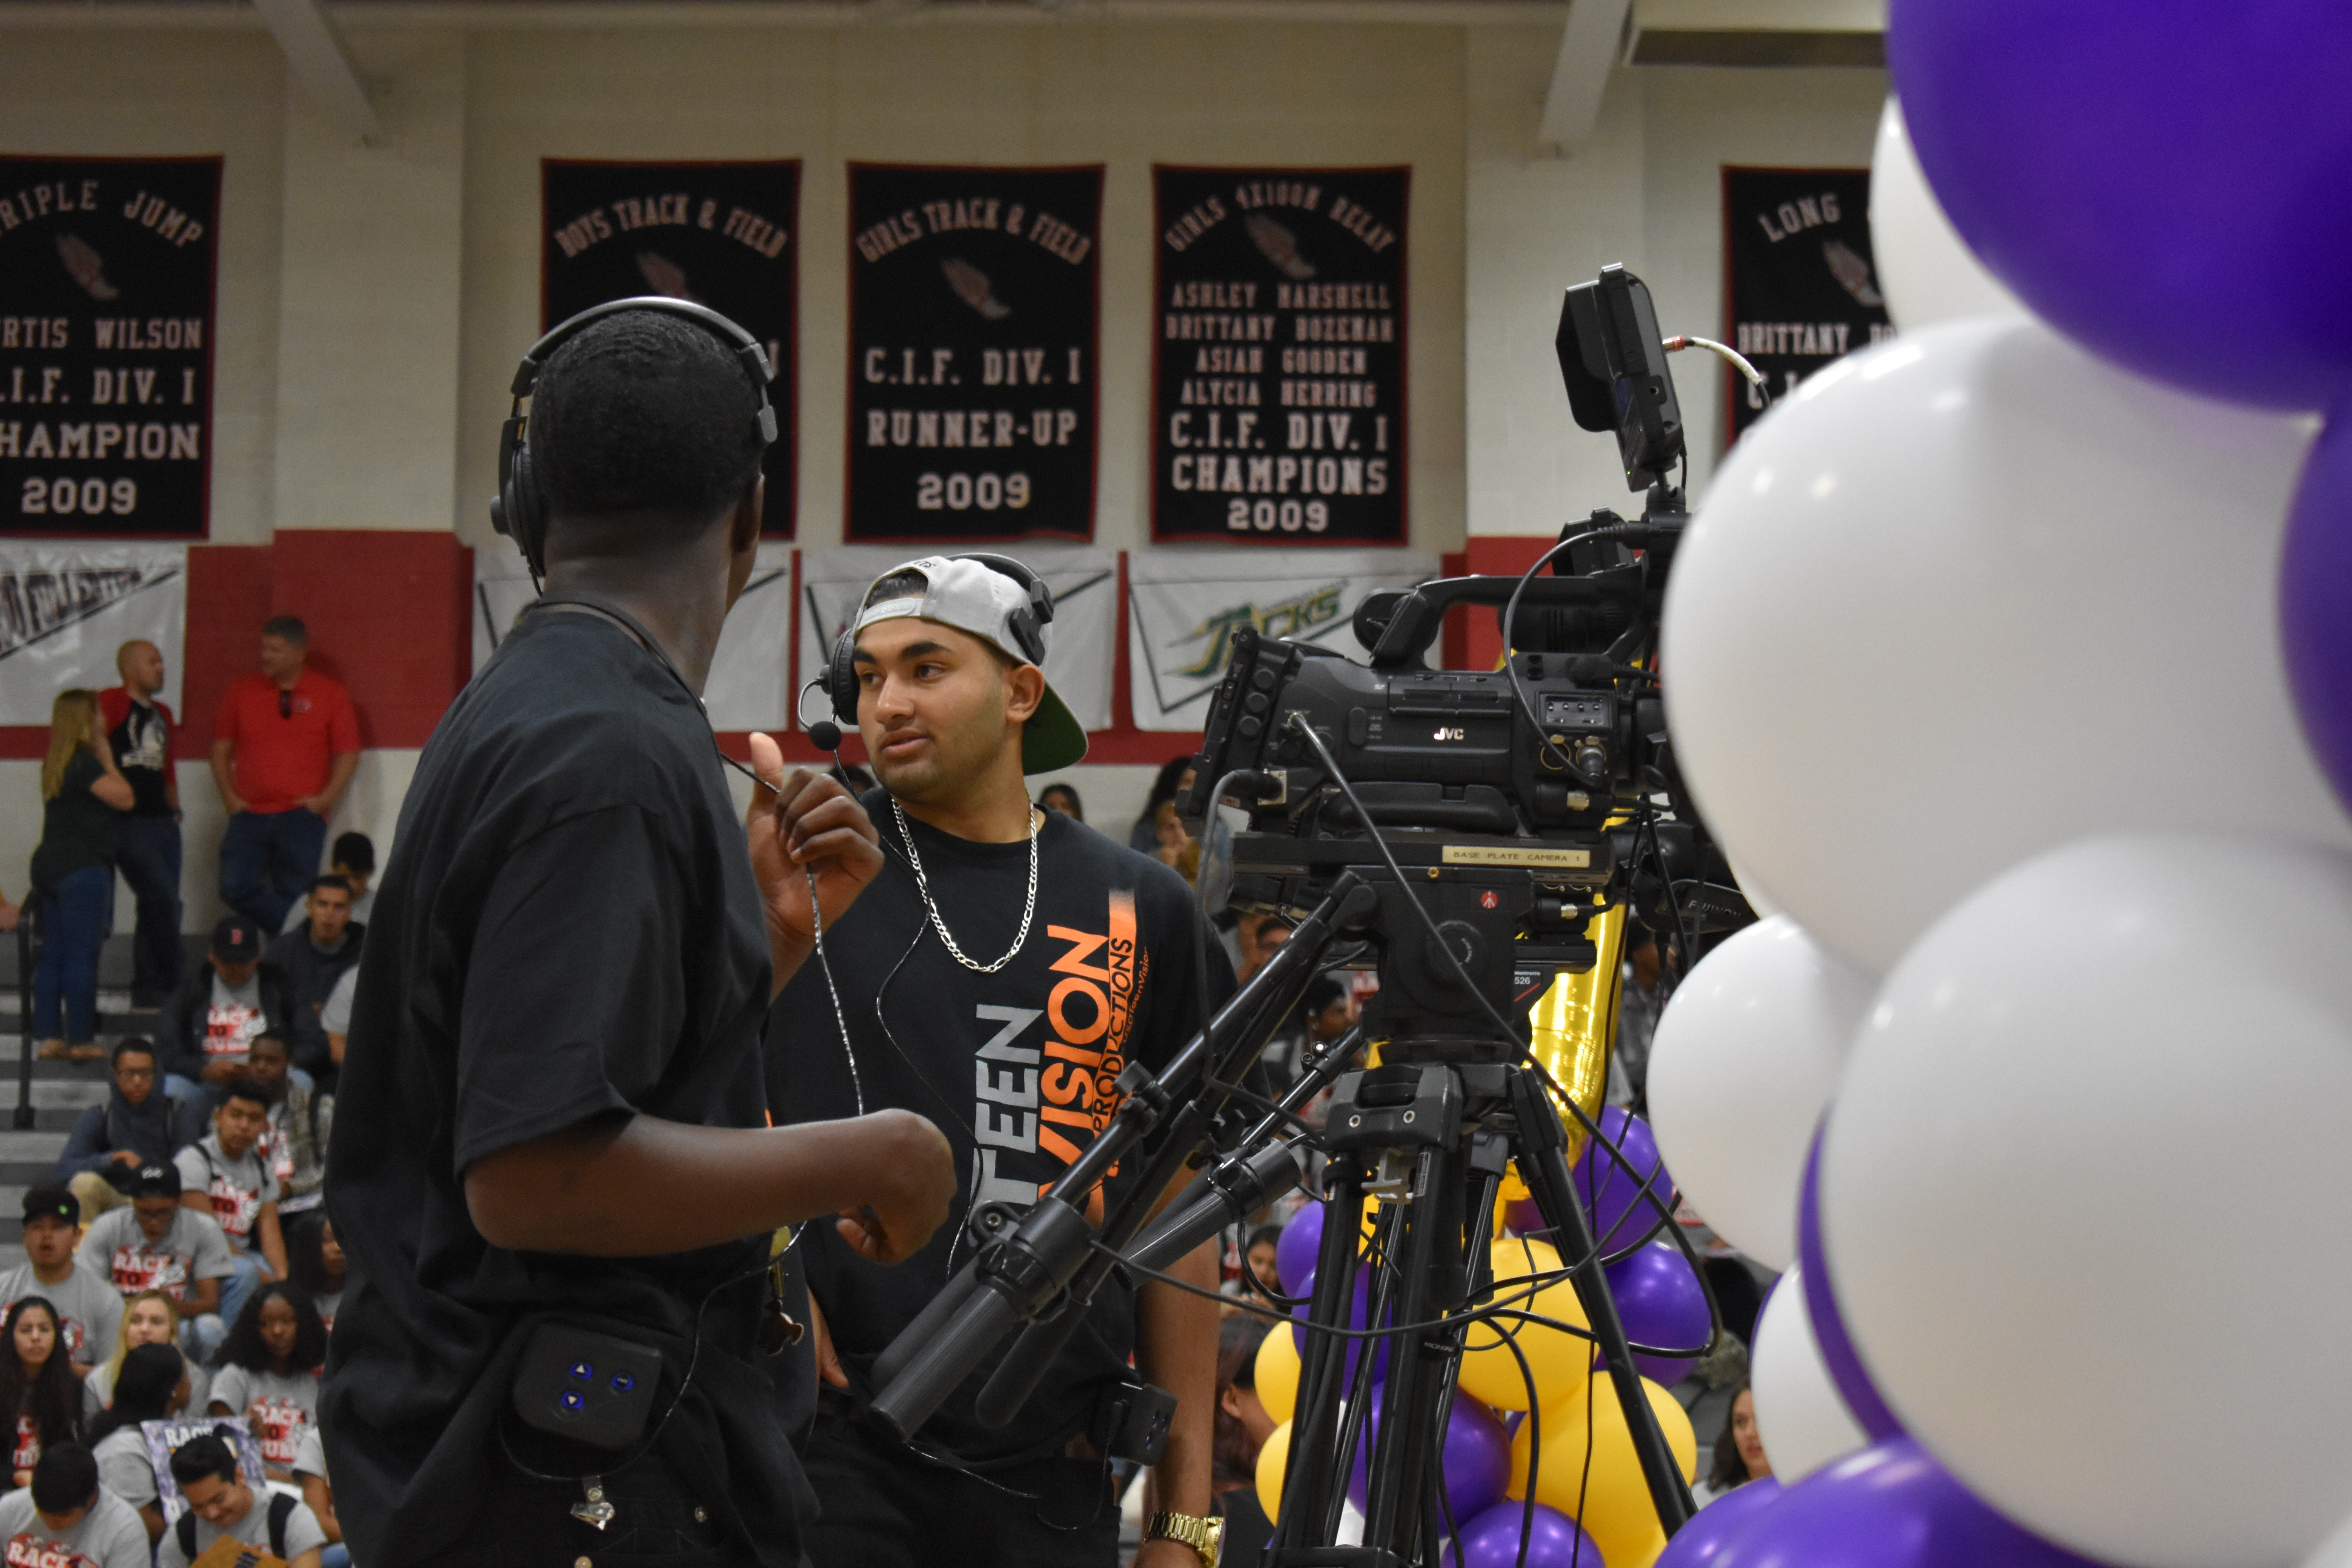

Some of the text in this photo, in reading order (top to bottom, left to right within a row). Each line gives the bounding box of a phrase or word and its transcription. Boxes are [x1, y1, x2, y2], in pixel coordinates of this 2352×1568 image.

[124, 190, 204, 248] JUMP
[554, 208, 612, 258] BOYS
[612, 195, 689, 231] TRACK
[723, 208, 788, 258] FIELD
[856, 210, 923, 263] GIRLS
[922, 199, 1002, 233] TRACK
[1030, 213, 1091, 265] FIELD
[1164, 195, 1227, 252] GIRLS
[1758, 192, 1842, 242] LONG
[1171, 282, 1257, 309] ASHLEY
[95, 318, 203, 349] WILSON
[1737, 322, 1849, 354] BRITTANY
[865, 347, 1081, 386] C.I.F. DIV. I
[93, 368, 164, 405] DIV.
[182, 368, 195, 405] I
[1180, 379, 1260, 406] ALYCIA
[0, 422, 200, 459] HAMPION
[867, 410, 1077, 447] RUNNER-UP
[1170, 412, 1265, 449] C.I.F.
[1288, 413, 1359, 450] DIV.
[918, 473, 1030, 510] 2009
[1172, 455, 1388, 495] CHAMPIONS
[21, 477, 137, 514] 2009
[1227, 498, 1328, 532] 2009
[1433, 727, 1465, 740] JVC
[1092, 938, 1132, 1132] PRODUCTIONS
[1037, 925, 1110, 1200] VISION
[969, 1004, 1044, 1225] TEEN
